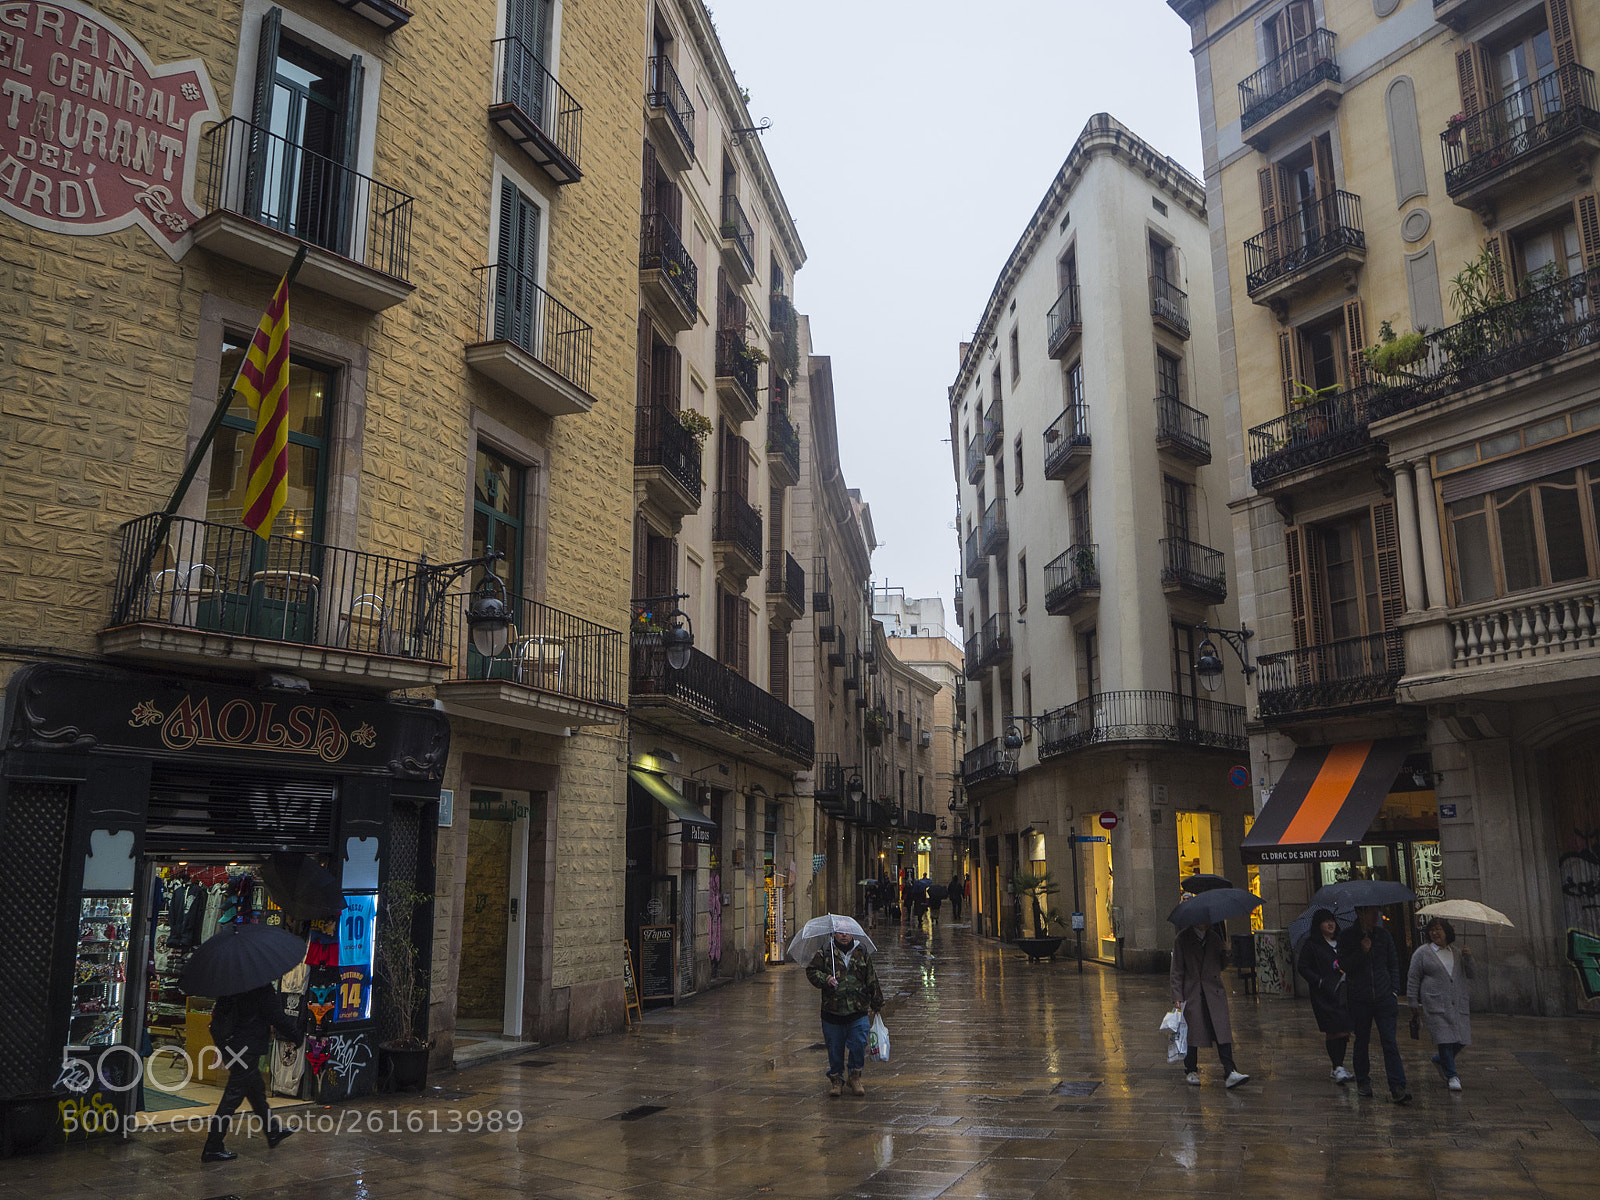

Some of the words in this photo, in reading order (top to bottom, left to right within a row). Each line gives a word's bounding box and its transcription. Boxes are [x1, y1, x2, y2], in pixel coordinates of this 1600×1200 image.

[0, 3, 136, 72] GRAN
[48, 52, 185, 132] CENTRAL
[2, 78, 184, 182] TAURANT
[161, 694, 349, 762] MOLSA
[1261, 852, 1269, 860] EL
[1270, 851, 1288, 860] DRAC
[1288, 851, 1298, 859] DE
[1299, 850, 1317, 859] SANT
[1318, 849, 1340, 858] JORDI
[348, 904, 364, 913] MESSI
[345, 915, 364, 941] 10
[643, 928, 672, 941] Tapas
[339, 983, 362, 1009] 14
